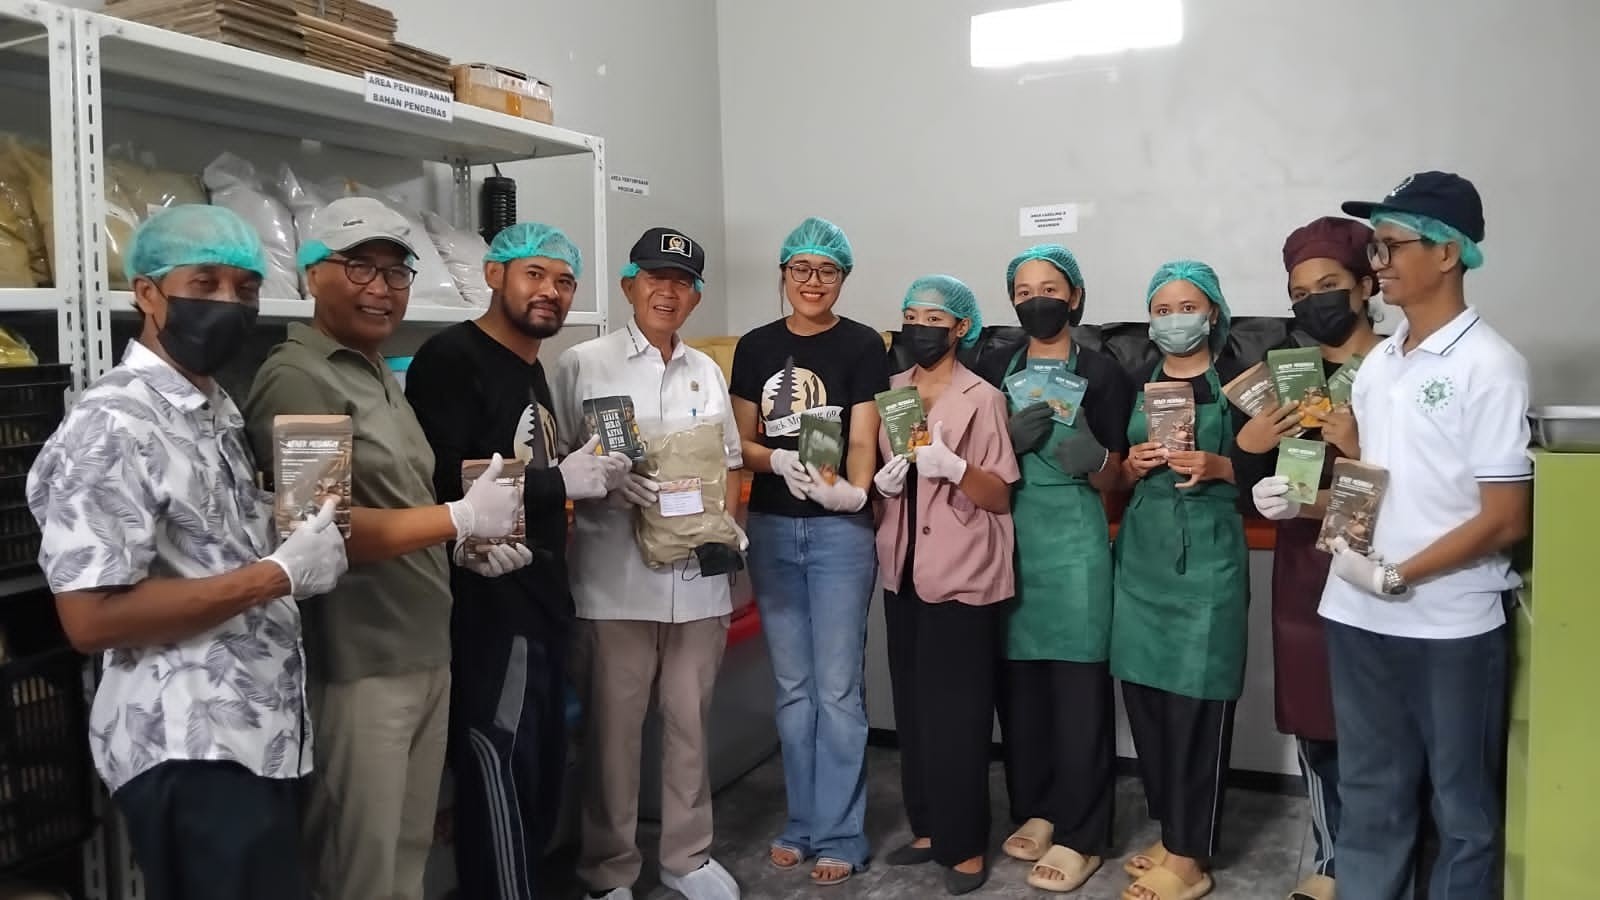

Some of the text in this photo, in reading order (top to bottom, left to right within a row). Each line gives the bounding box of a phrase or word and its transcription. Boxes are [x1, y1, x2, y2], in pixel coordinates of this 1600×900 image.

[368, 75, 451, 104] AREA PENYIMPANAN
[373, 93, 447, 118] BAHAN PENGEMAS
